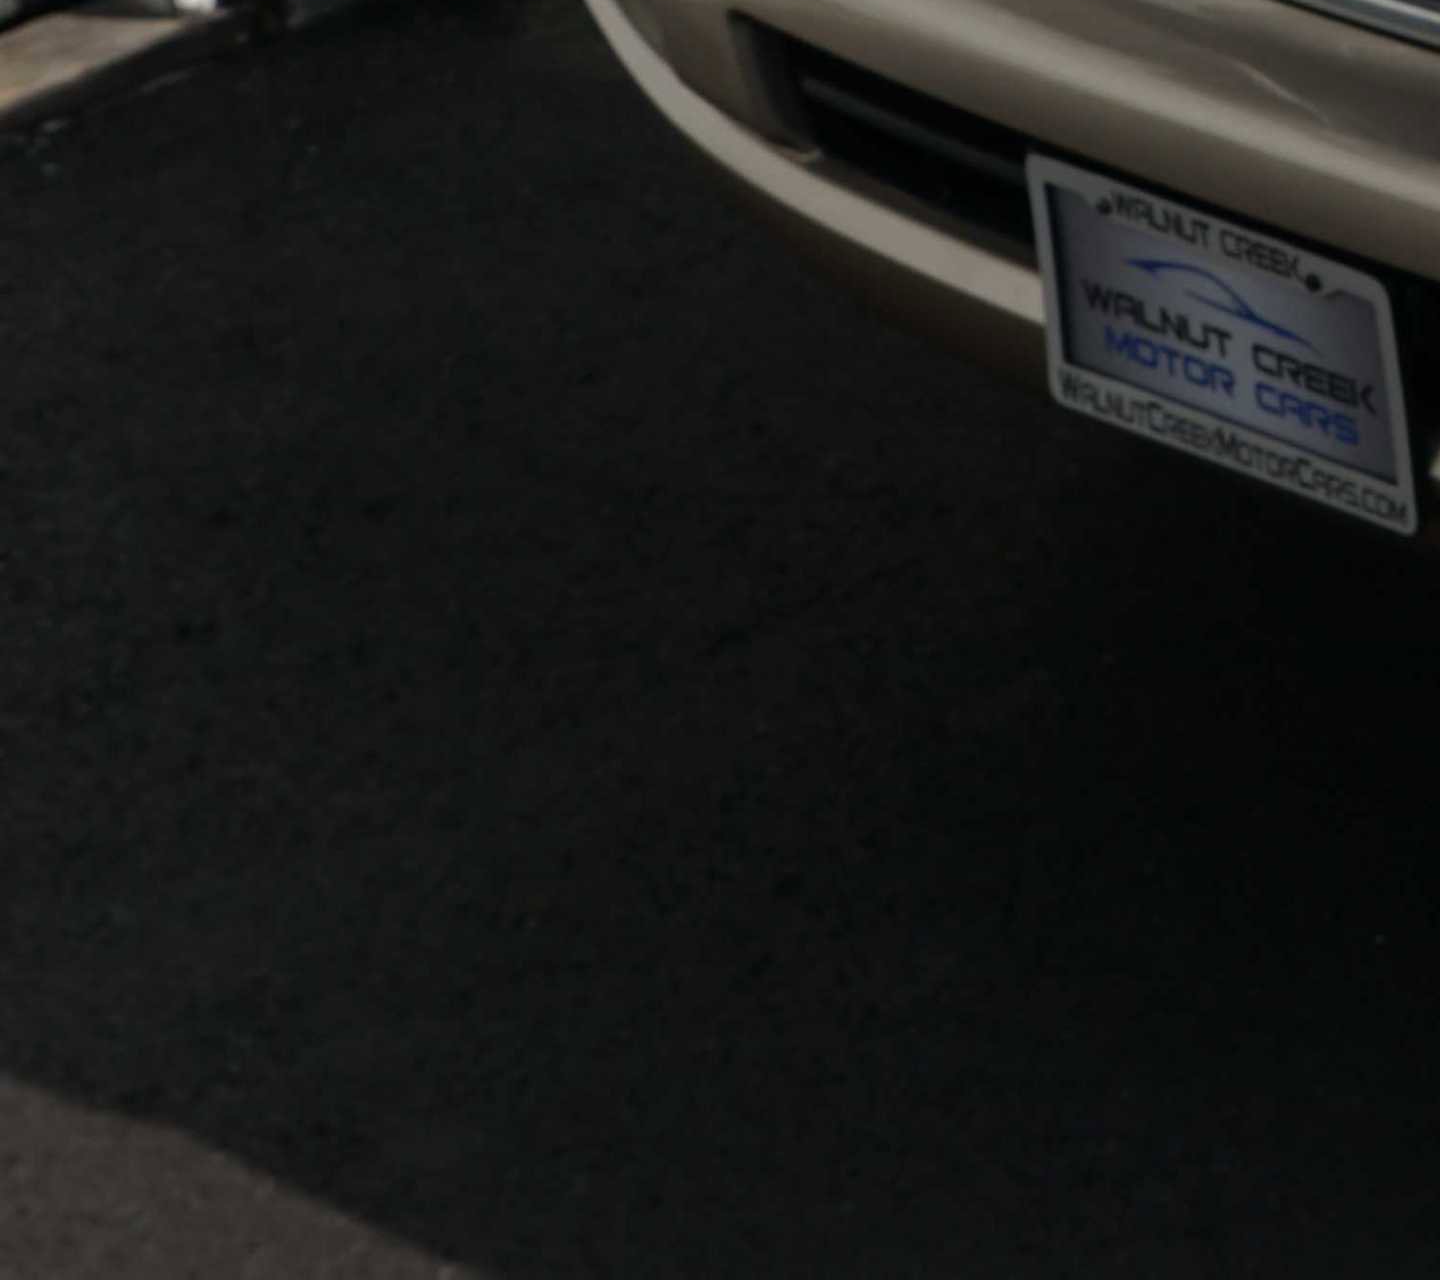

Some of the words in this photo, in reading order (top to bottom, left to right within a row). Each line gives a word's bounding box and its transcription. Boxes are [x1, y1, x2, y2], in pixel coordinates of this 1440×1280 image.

[1112, 191, 1211, 249] WALNUT
[1082, 277, 1233, 358] WALNUT
[1250, 342, 1377, 415] CREEK
[1103, 324, 1237, 398] MOTOR
[1255, 382, 1361, 446] CARS
